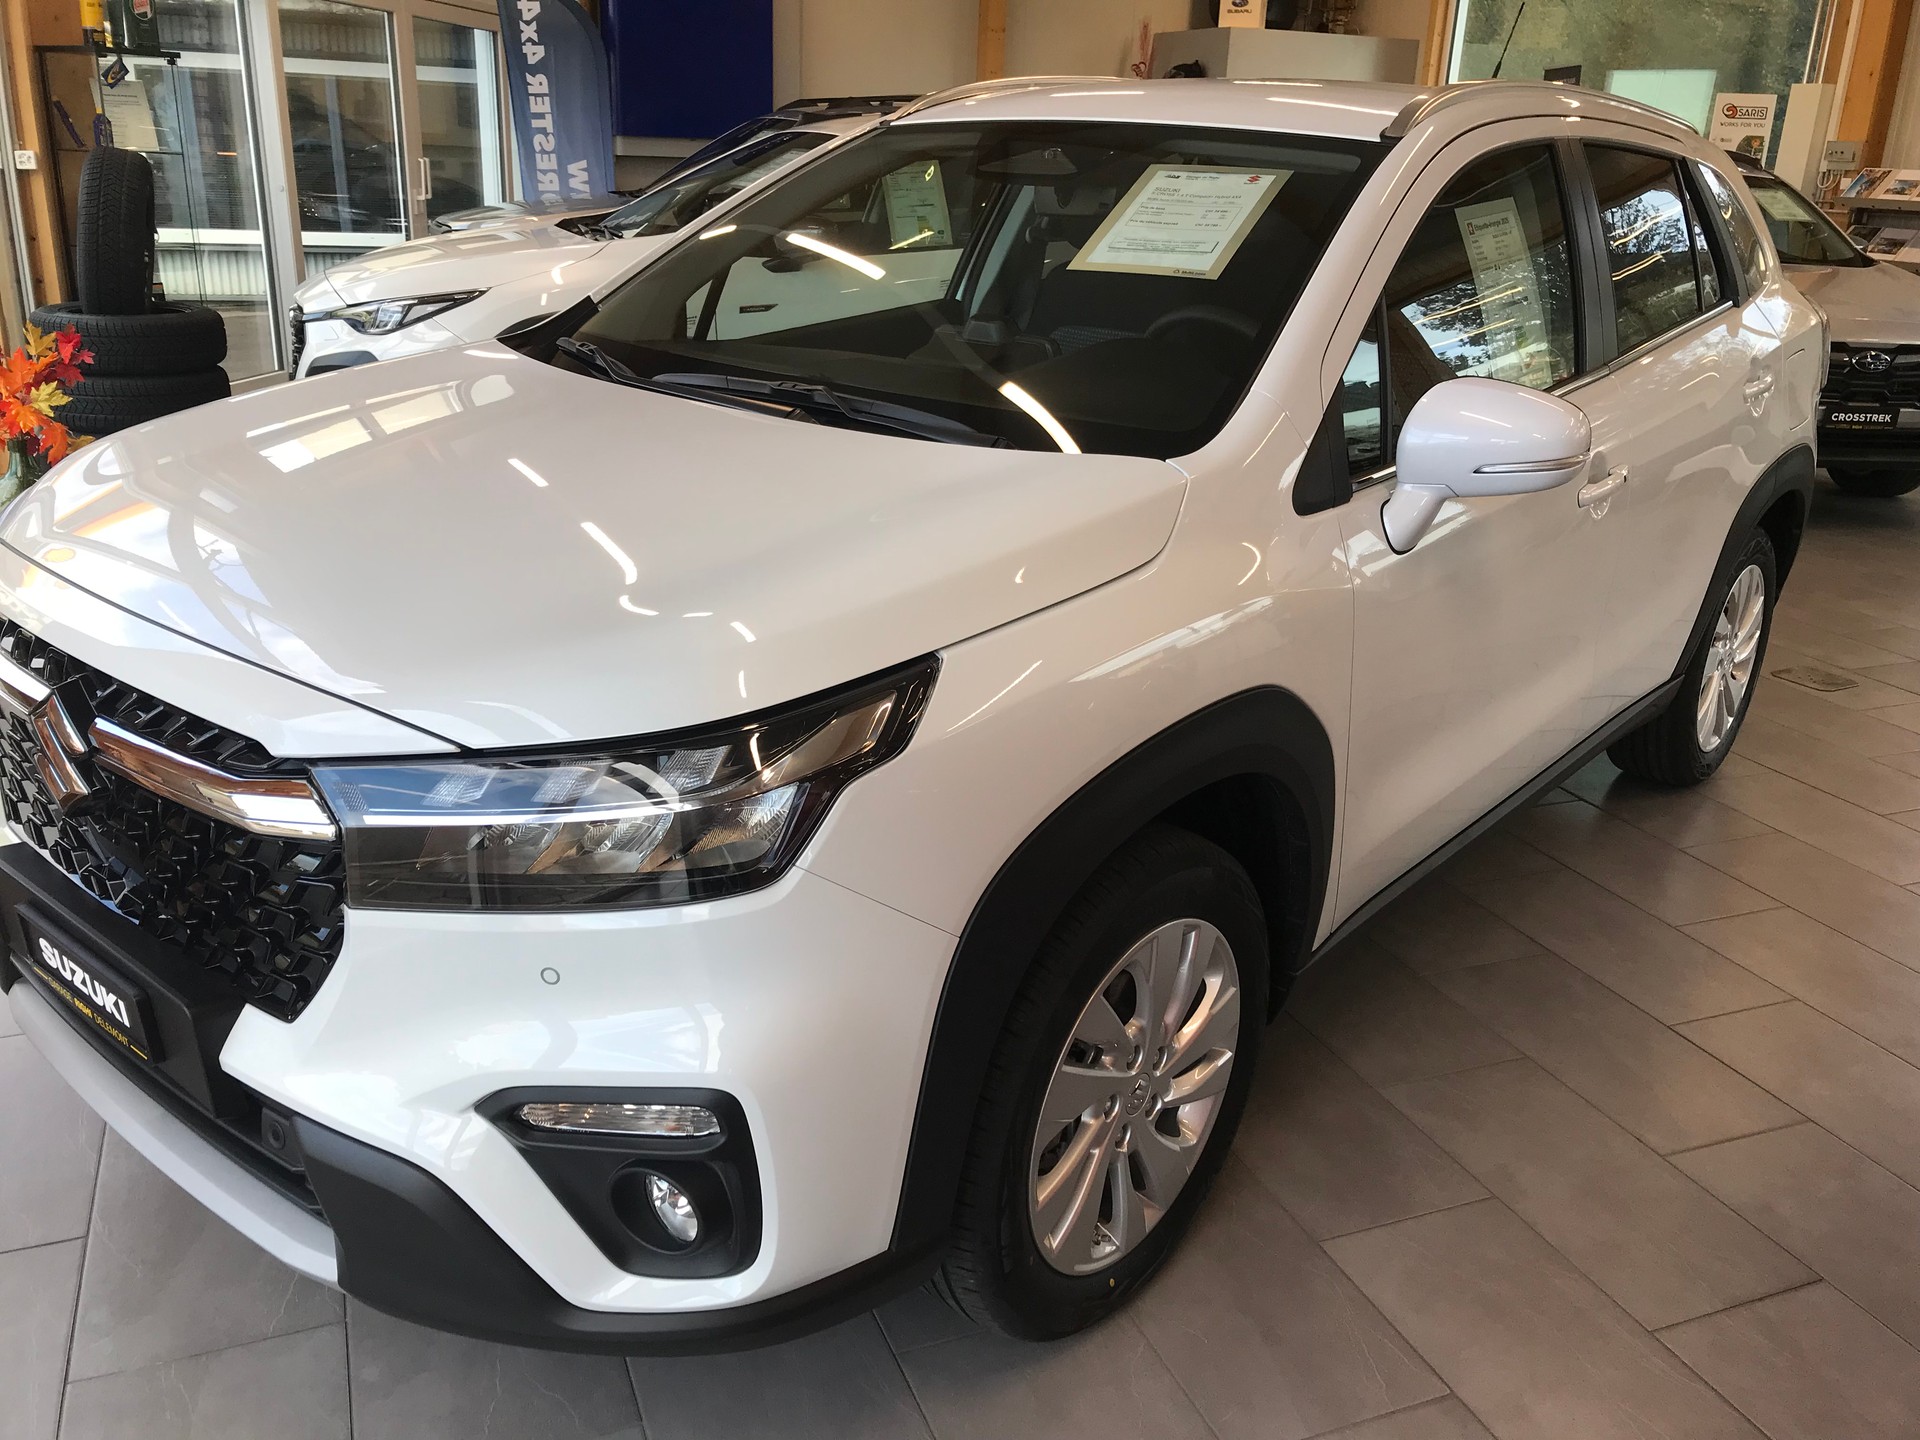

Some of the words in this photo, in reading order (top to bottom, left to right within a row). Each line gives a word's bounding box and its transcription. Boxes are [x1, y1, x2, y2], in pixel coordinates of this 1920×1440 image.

[1738, 108, 1765, 118] SARIS
[1831, 413, 1892, 423] CROSSTREK
[38, 937, 131, 1029] SUZUKI
